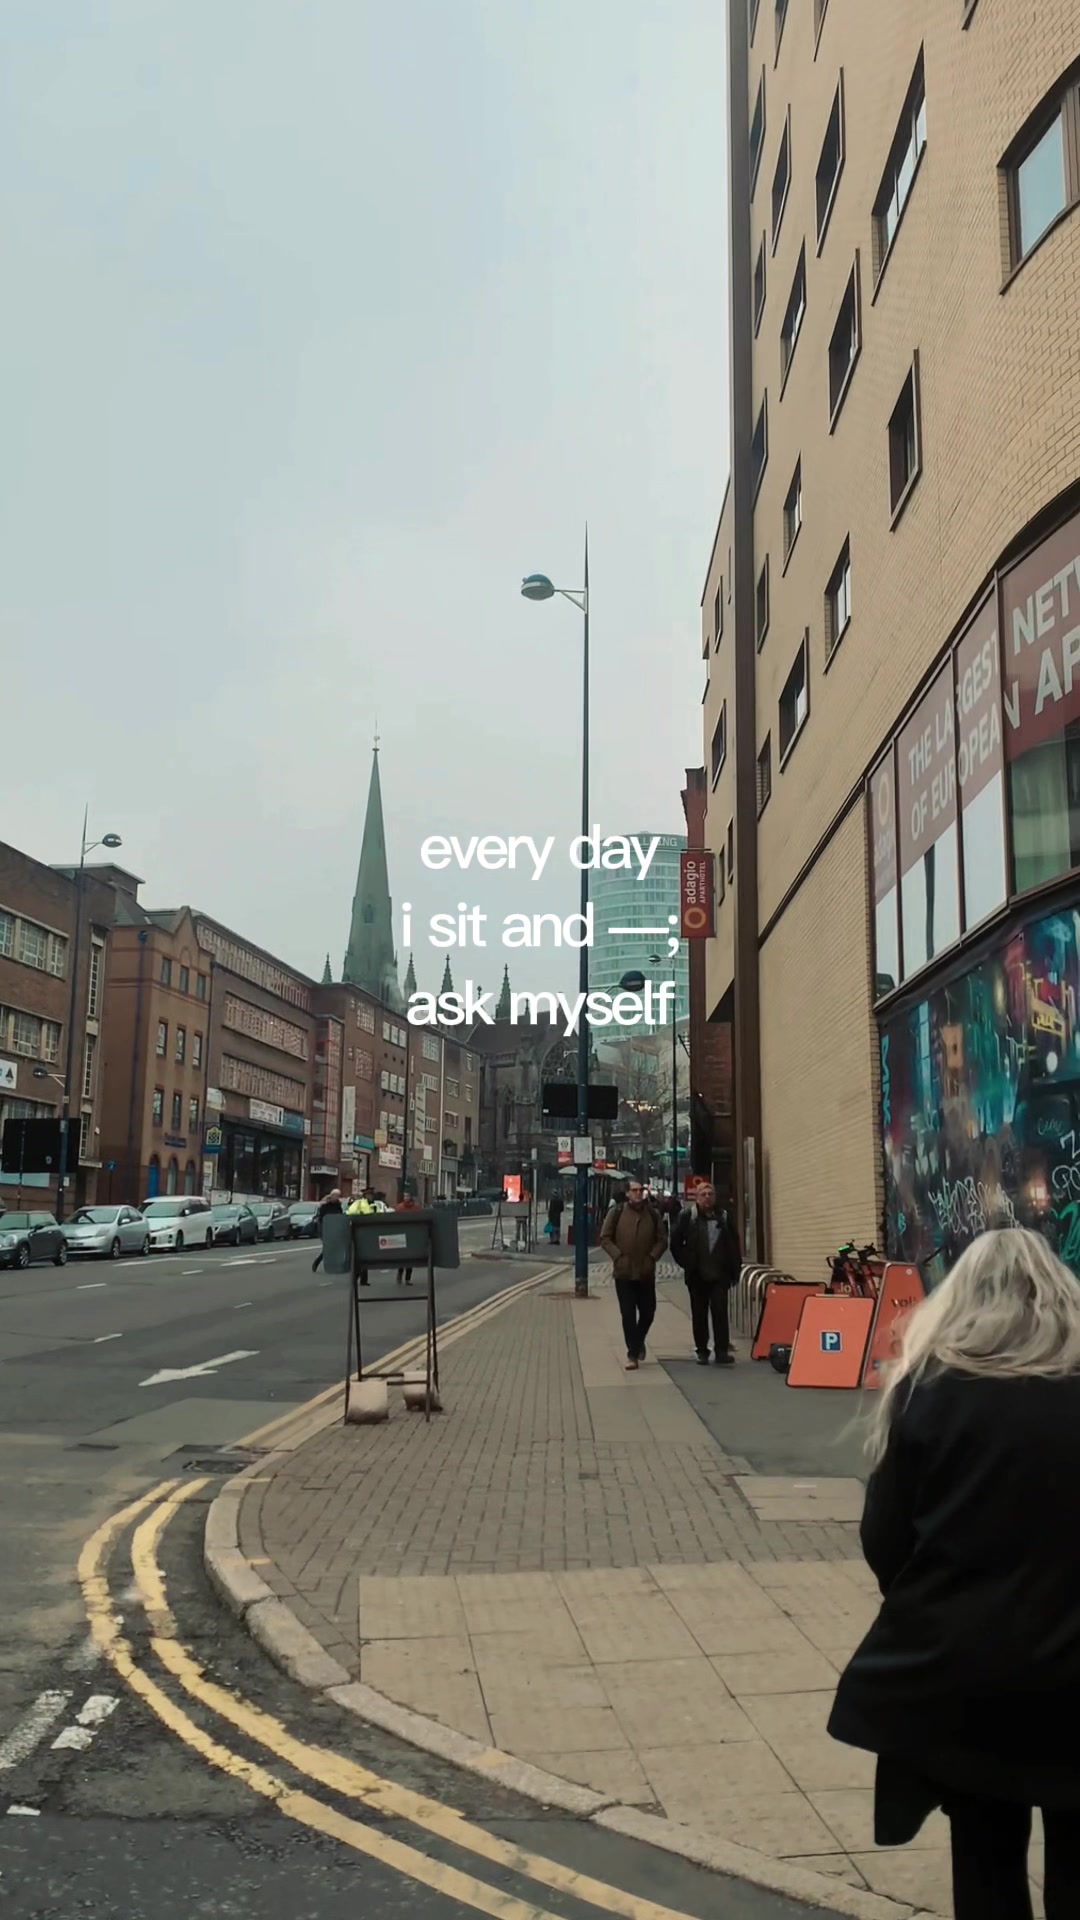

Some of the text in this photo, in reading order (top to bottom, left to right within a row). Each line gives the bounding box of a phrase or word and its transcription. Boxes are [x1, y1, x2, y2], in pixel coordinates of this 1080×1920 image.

[909, 735, 932, 785] THE
[911, 789, 928, 841] OF
[684, 861, 699, 904] adagio
[825, 1332, 838, 1350] P
